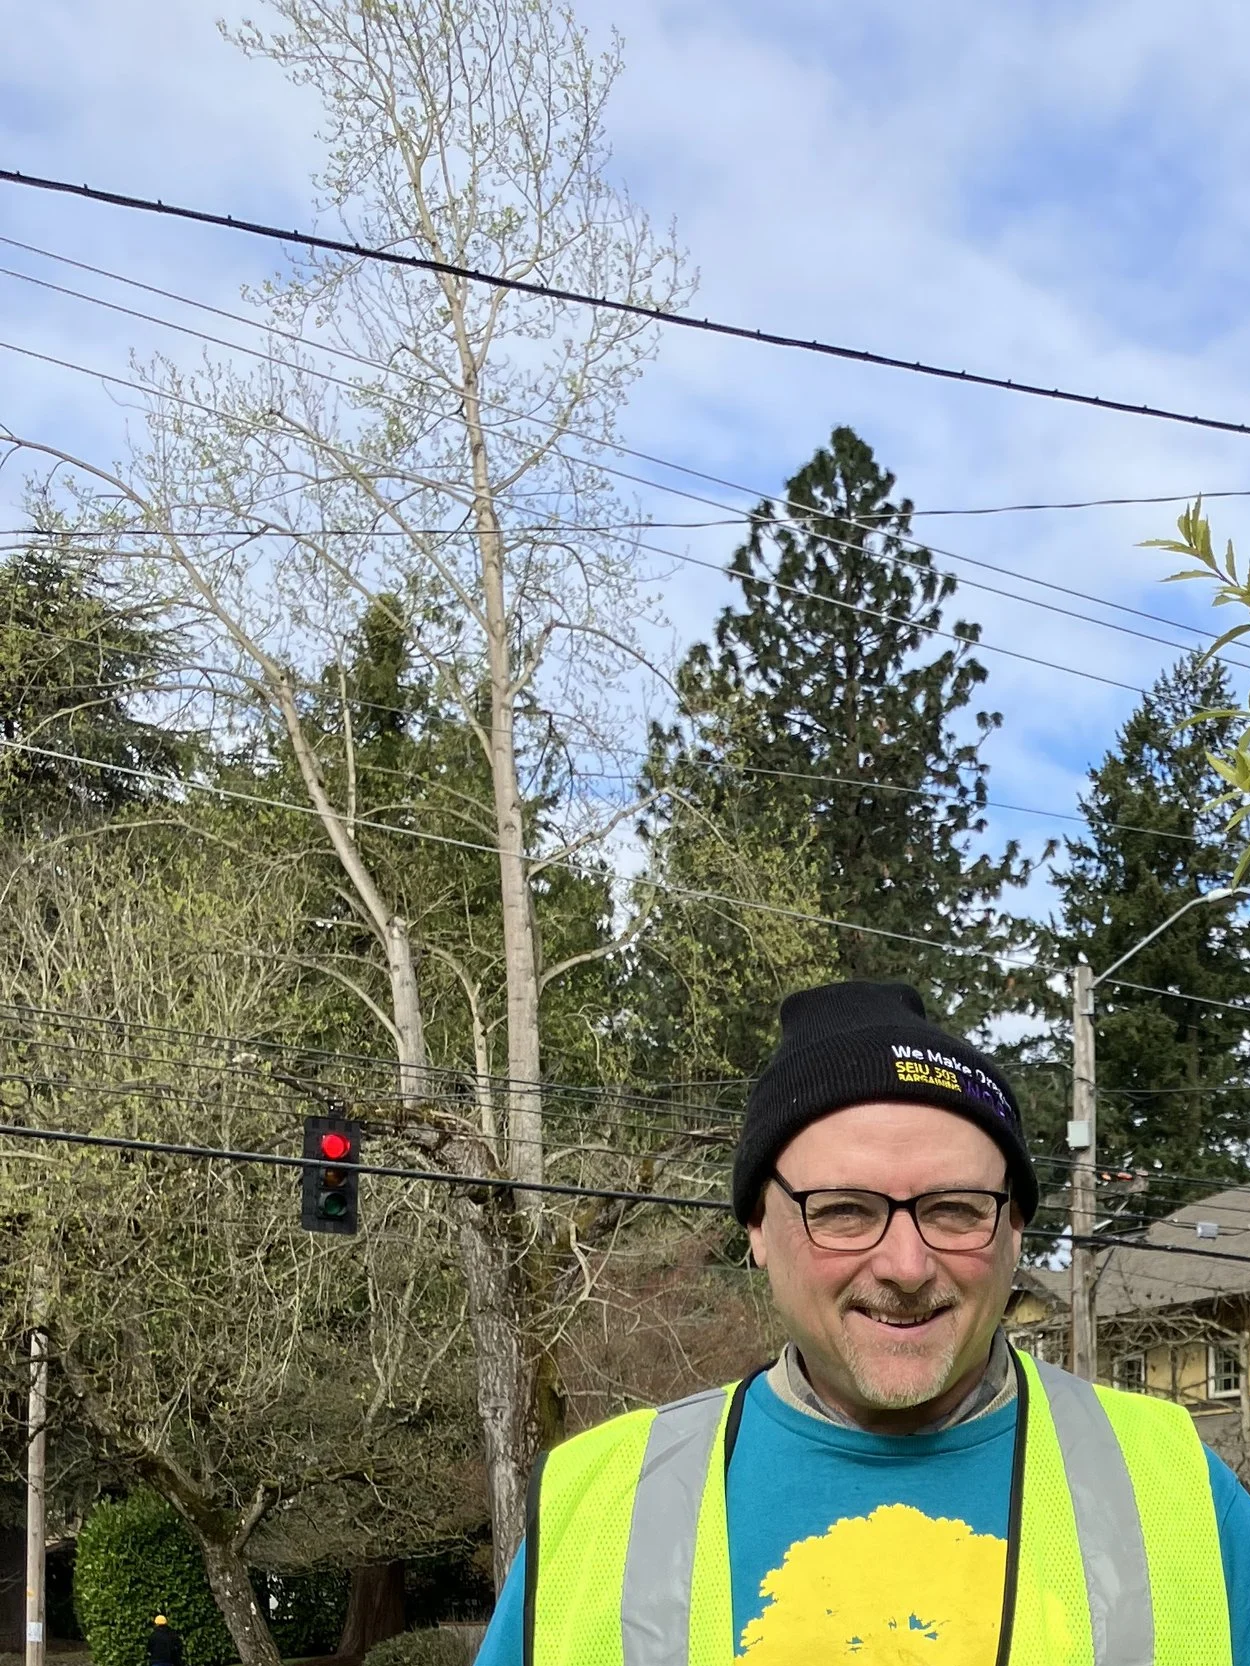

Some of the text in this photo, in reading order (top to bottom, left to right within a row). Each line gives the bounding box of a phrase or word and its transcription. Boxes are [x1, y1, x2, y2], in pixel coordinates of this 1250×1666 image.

[891, 1045, 924, 1060] We
[926, 1049, 973, 1077] Make
[895, 1061, 958, 1084] SEIU 503
